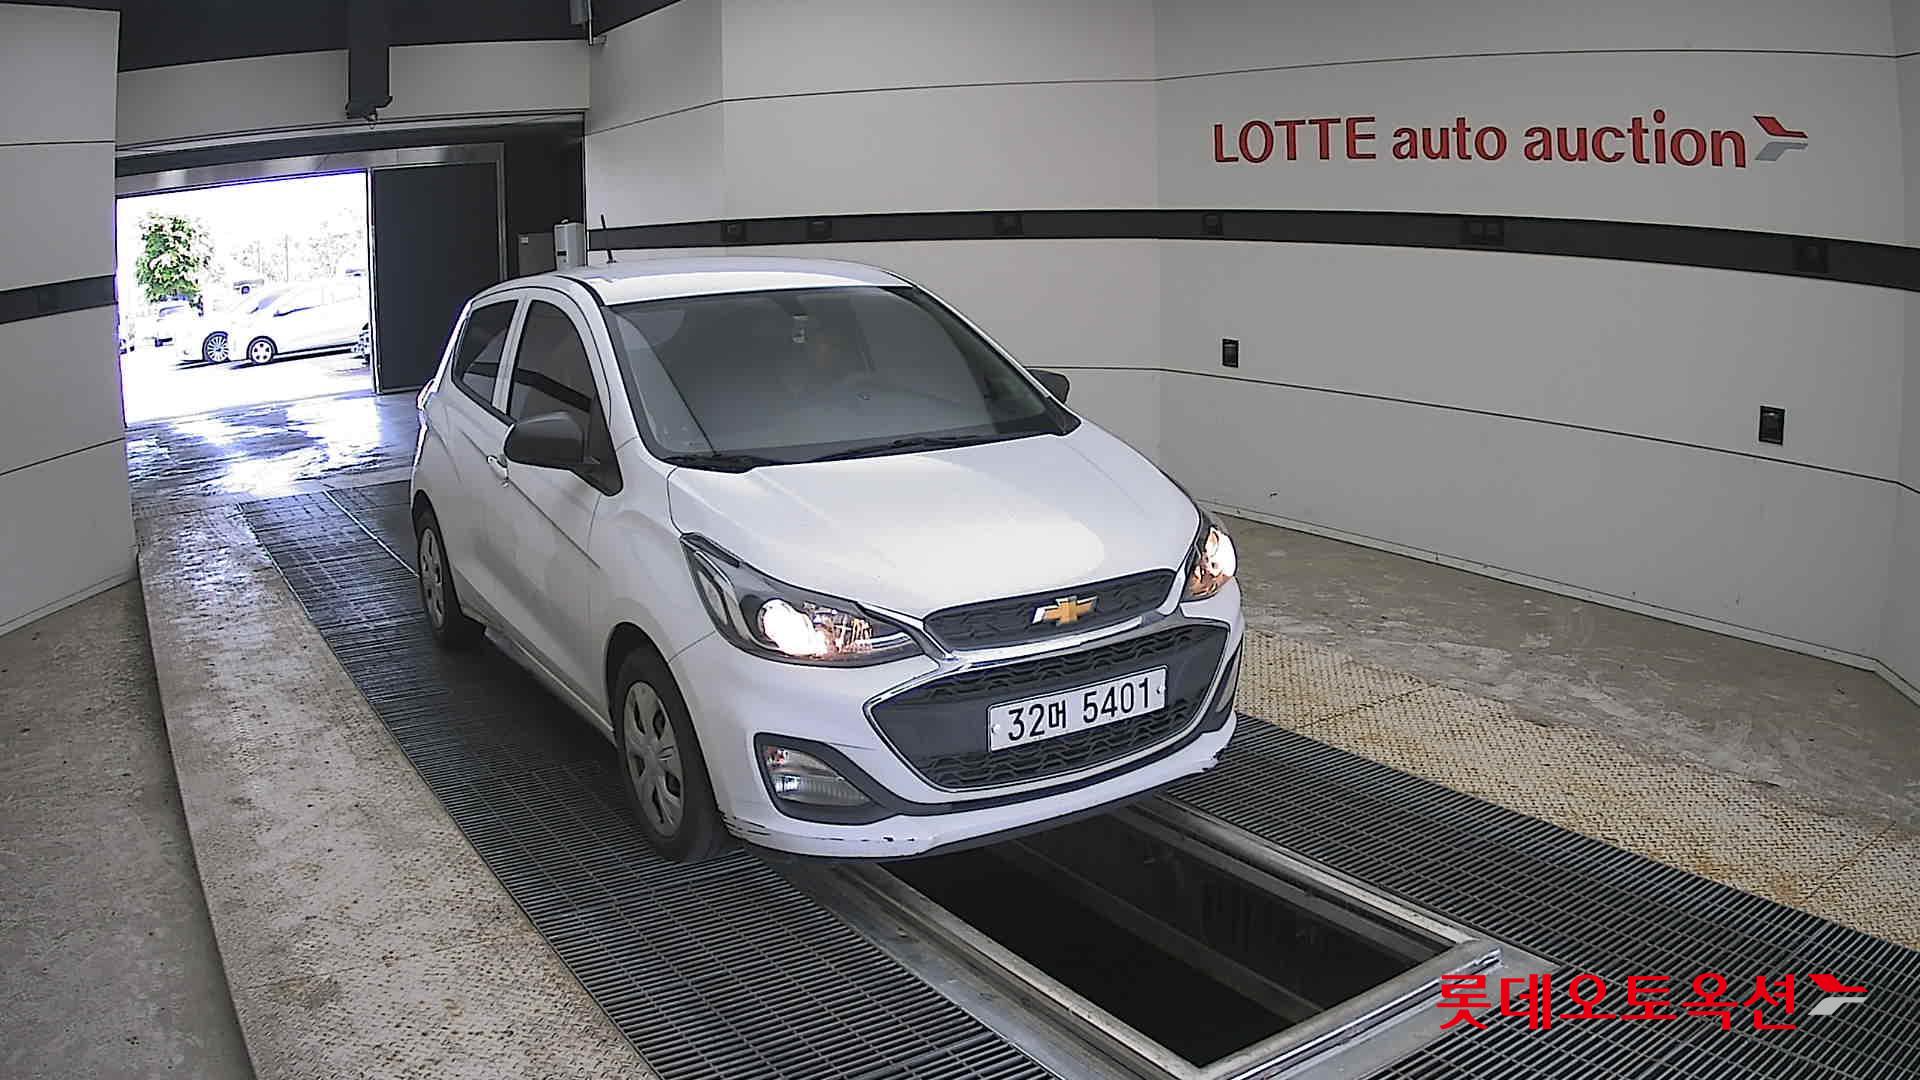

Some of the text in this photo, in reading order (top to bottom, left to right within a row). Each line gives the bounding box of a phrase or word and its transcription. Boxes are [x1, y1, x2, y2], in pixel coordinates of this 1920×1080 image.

[1213, 109, 1747, 168] LOTTE auto auction
[1083, 677, 1149, 723] 5401
